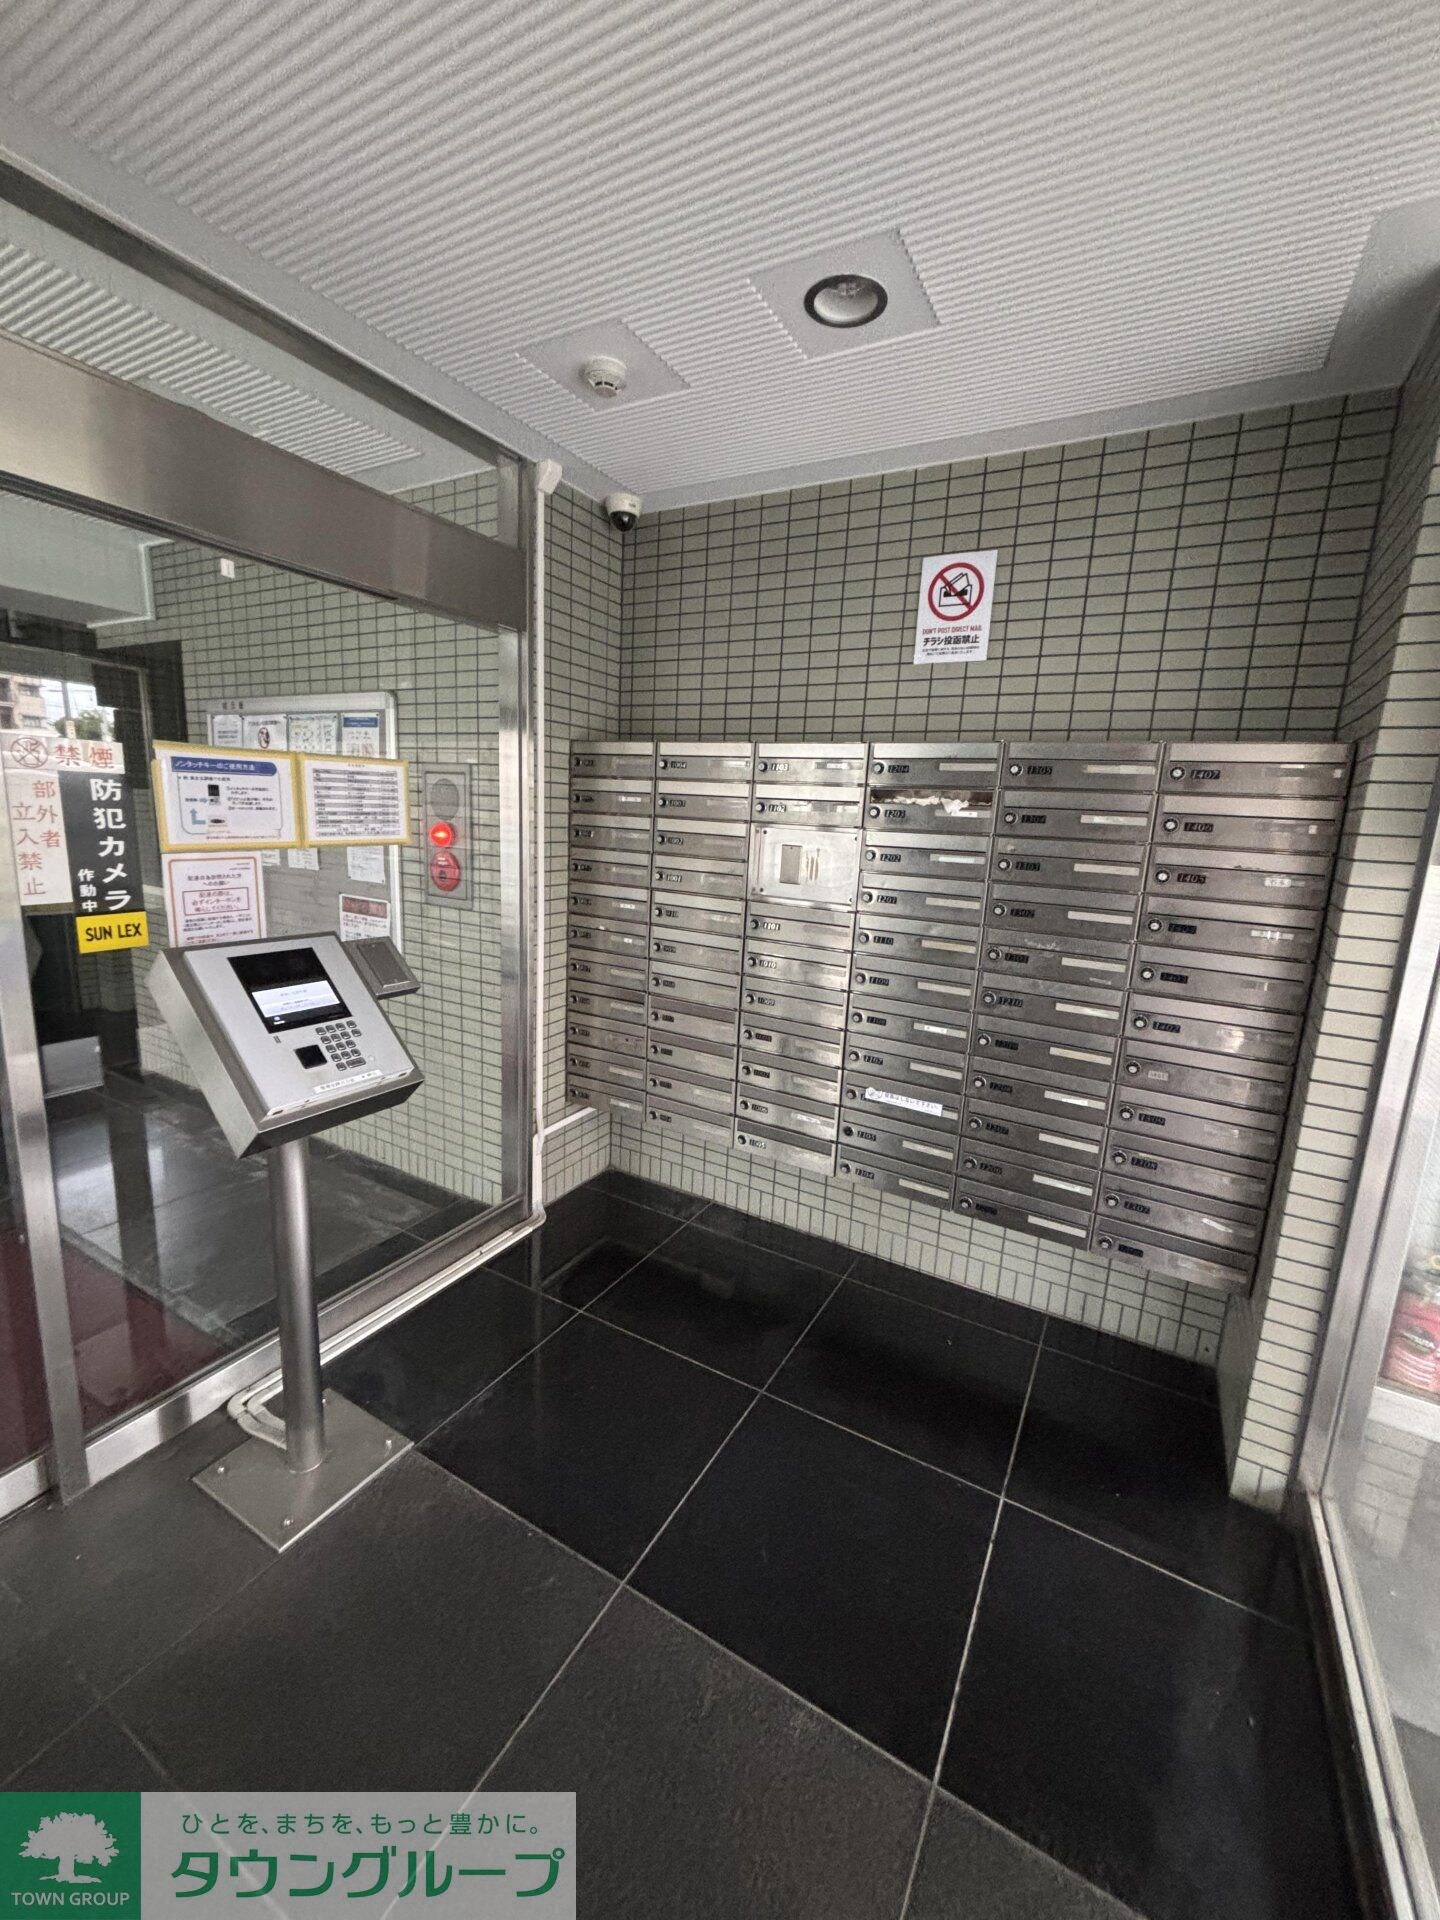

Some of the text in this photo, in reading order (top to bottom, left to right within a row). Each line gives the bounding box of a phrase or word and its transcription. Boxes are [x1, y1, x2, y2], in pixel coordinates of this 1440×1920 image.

[951, 625, 969, 633] DIRECT
[923, 635, 980, 646] チラシ投函禁止
[55, 743, 115, 769] 禁煙
[771, 763, 789, 771] 1103
[1190, 769, 1220, 779] 1407
[32, 779, 62, 849] 部外者
[768, 804, 787, 813] 1102
[884, 809, 906, 818] 1203
[12, 802, 47, 897] 立入禁止
[89, 778, 132, 911] 防犯カメラ
[880, 853, 902, 863] 1202
[1177, 873, 1207, 884] 1405
[77, 868, 98, 912] 作動中
[85, 923, 142, 941] SUN LEX
[763, 922, 780, 931] 1101
